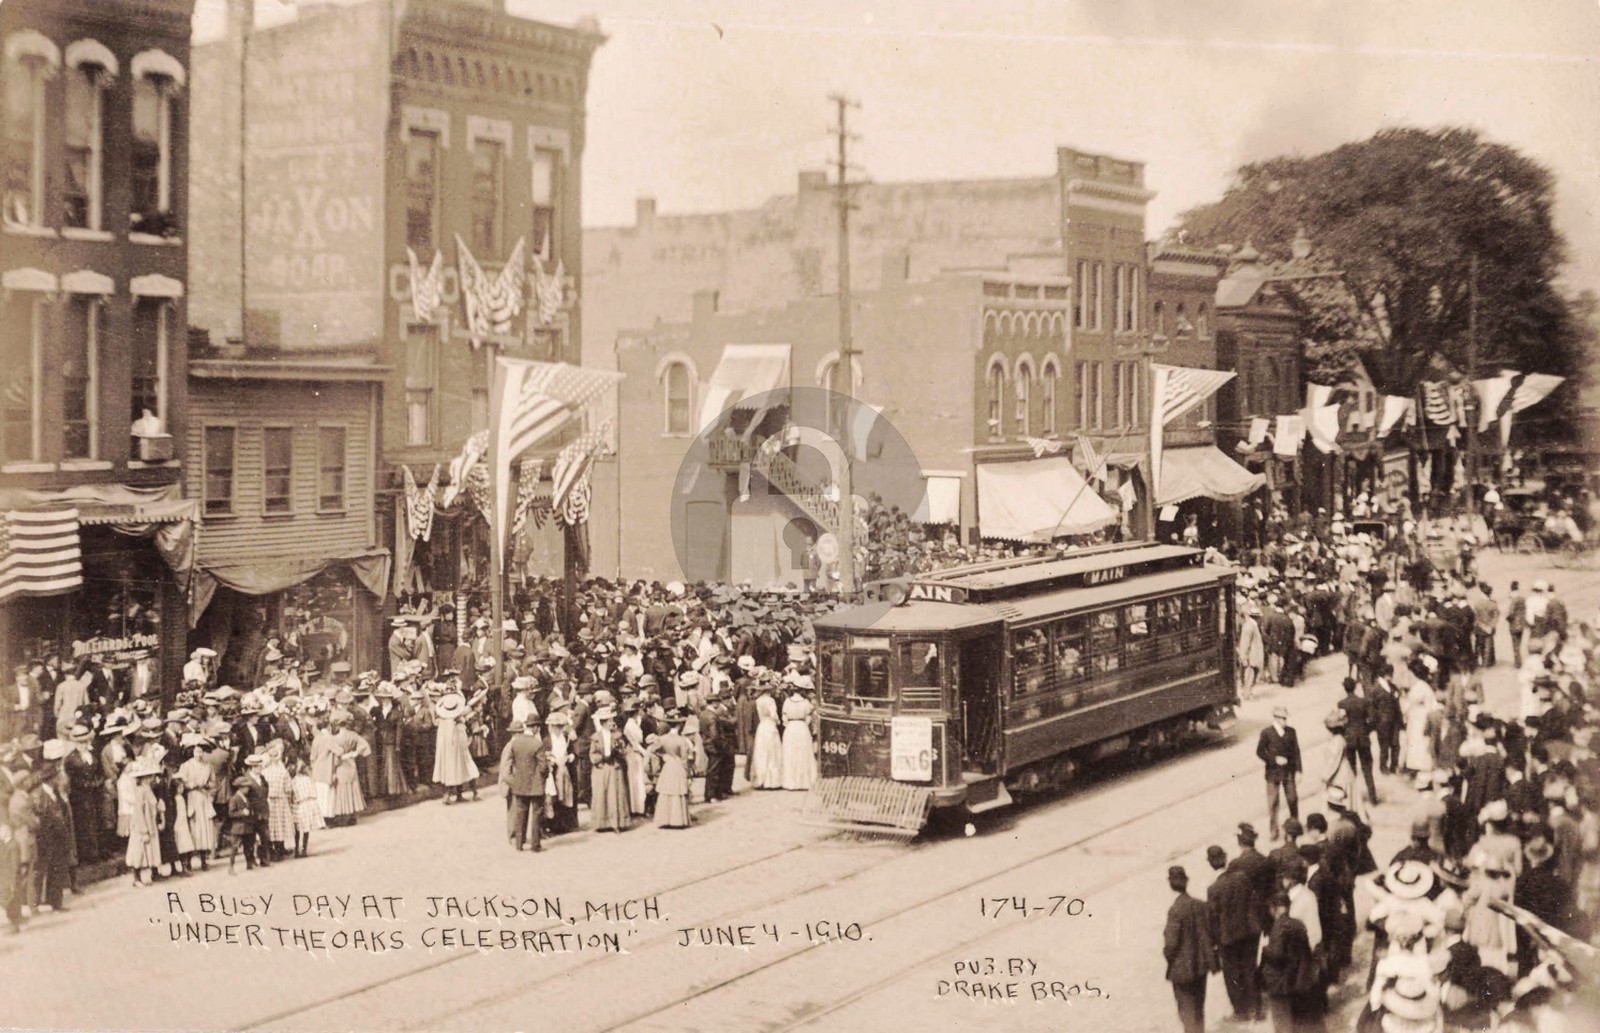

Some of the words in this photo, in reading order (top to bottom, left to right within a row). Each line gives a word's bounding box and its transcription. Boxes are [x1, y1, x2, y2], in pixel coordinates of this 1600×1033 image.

[249, 186, 374, 249] JAXON
[1091, 566, 1124, 585] MAIN
[908, 583, 951, 602] AIN
[821, 740, 847, 756] 496
[918, 749, 930, 772] 6
